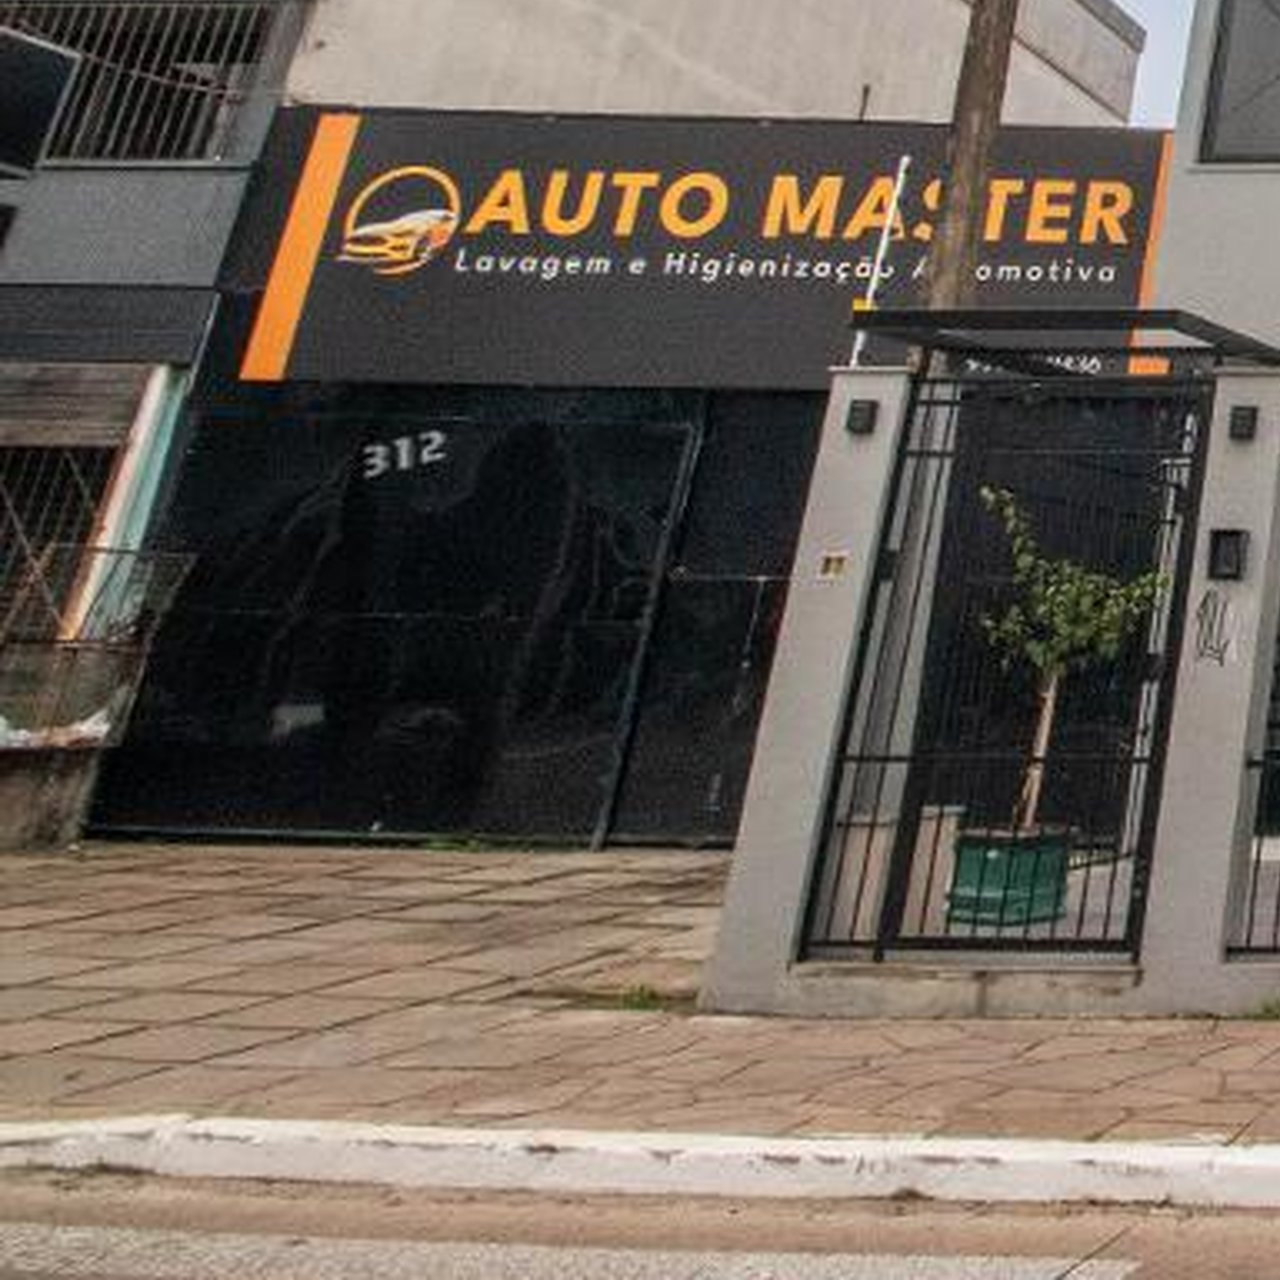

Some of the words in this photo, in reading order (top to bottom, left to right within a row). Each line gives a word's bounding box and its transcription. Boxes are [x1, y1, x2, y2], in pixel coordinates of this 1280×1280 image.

[463, 168, 729, 239] AUTO
[455, 248, 612, 280] Lavagem
[629, 257, 647, 274] e
[665, 252, 895, 284] Higienização
[912, 255, 1117, 283] omotiva
[363, 429, 448, 478] 312
